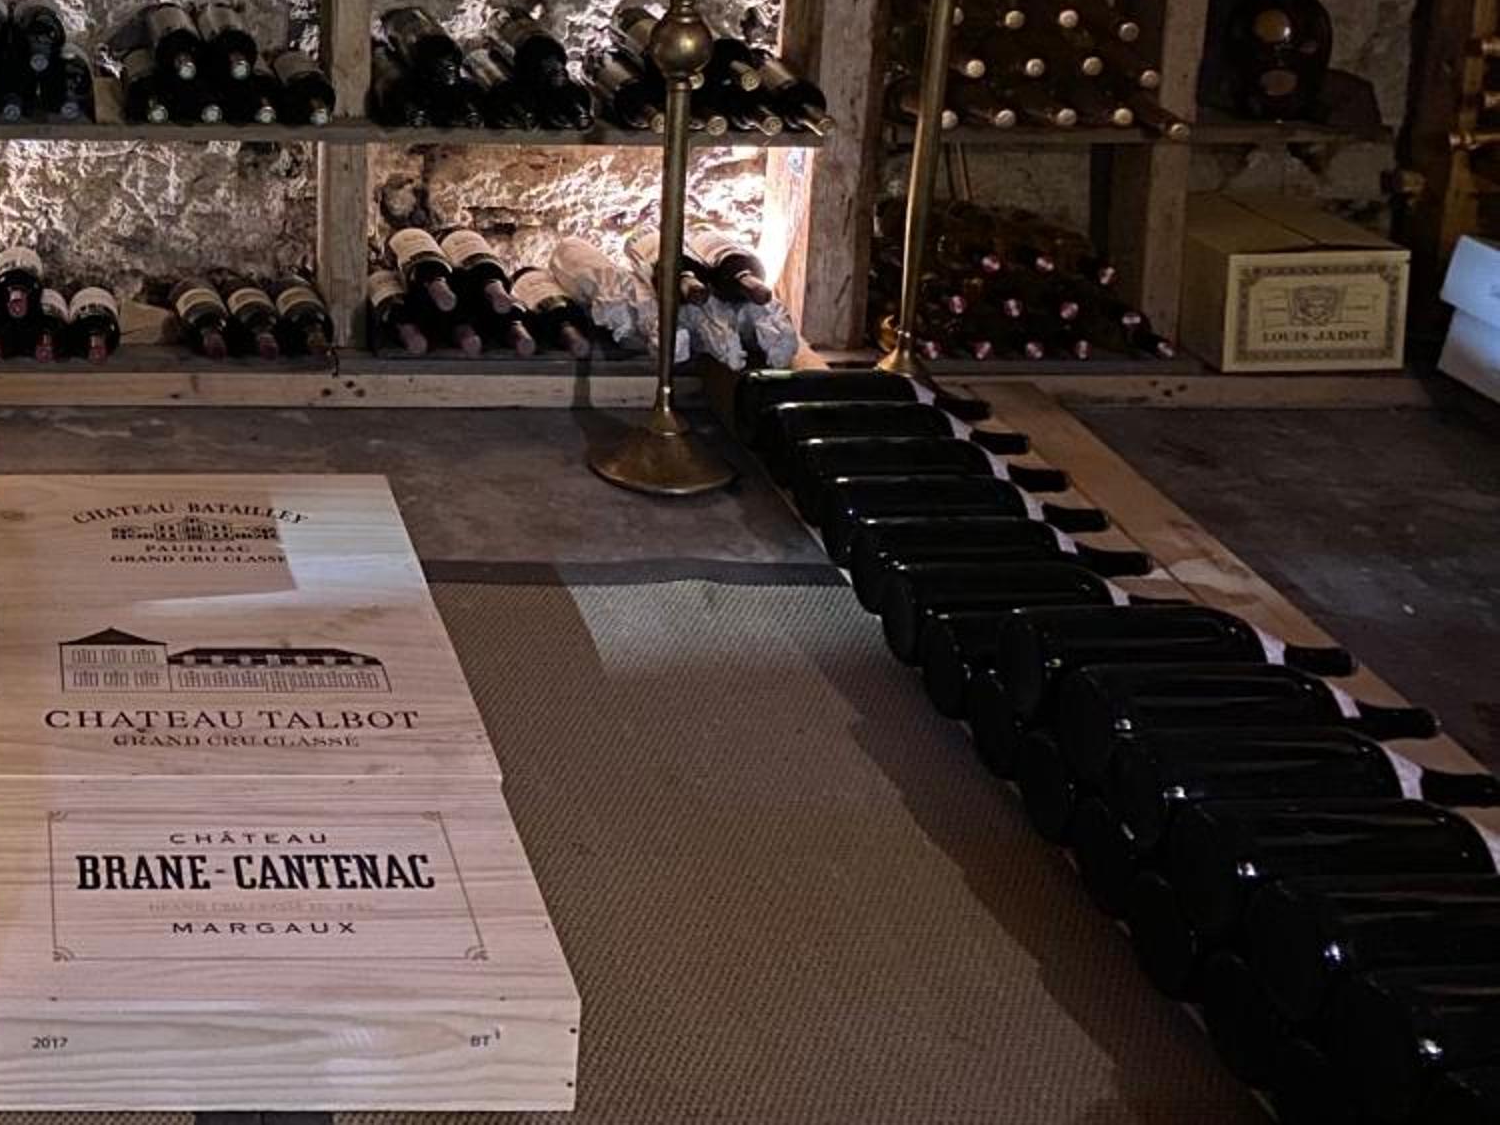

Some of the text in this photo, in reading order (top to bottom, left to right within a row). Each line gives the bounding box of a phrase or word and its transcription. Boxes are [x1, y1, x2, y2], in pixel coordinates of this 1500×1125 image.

[1262, 330, 1371, 344] LOUIS JADOT
[72, 503, 175, 524] CHATEAU
[143, 544, 251, 554] PAUILLAC
[110, 555, 176, 564] GRAND
[180, 555, 218, 564] CRU
[45, 710, 419, 730] CHATEAU TALBOT
[113, 734, 201, 747] GRAND
[207, 734, 256, 747] CRU
[169, 830, 328, 844] CHÂTEAU
[172, 922, 357, 934] MARGAUX
[31, 1035, 68, 1050] 2017
